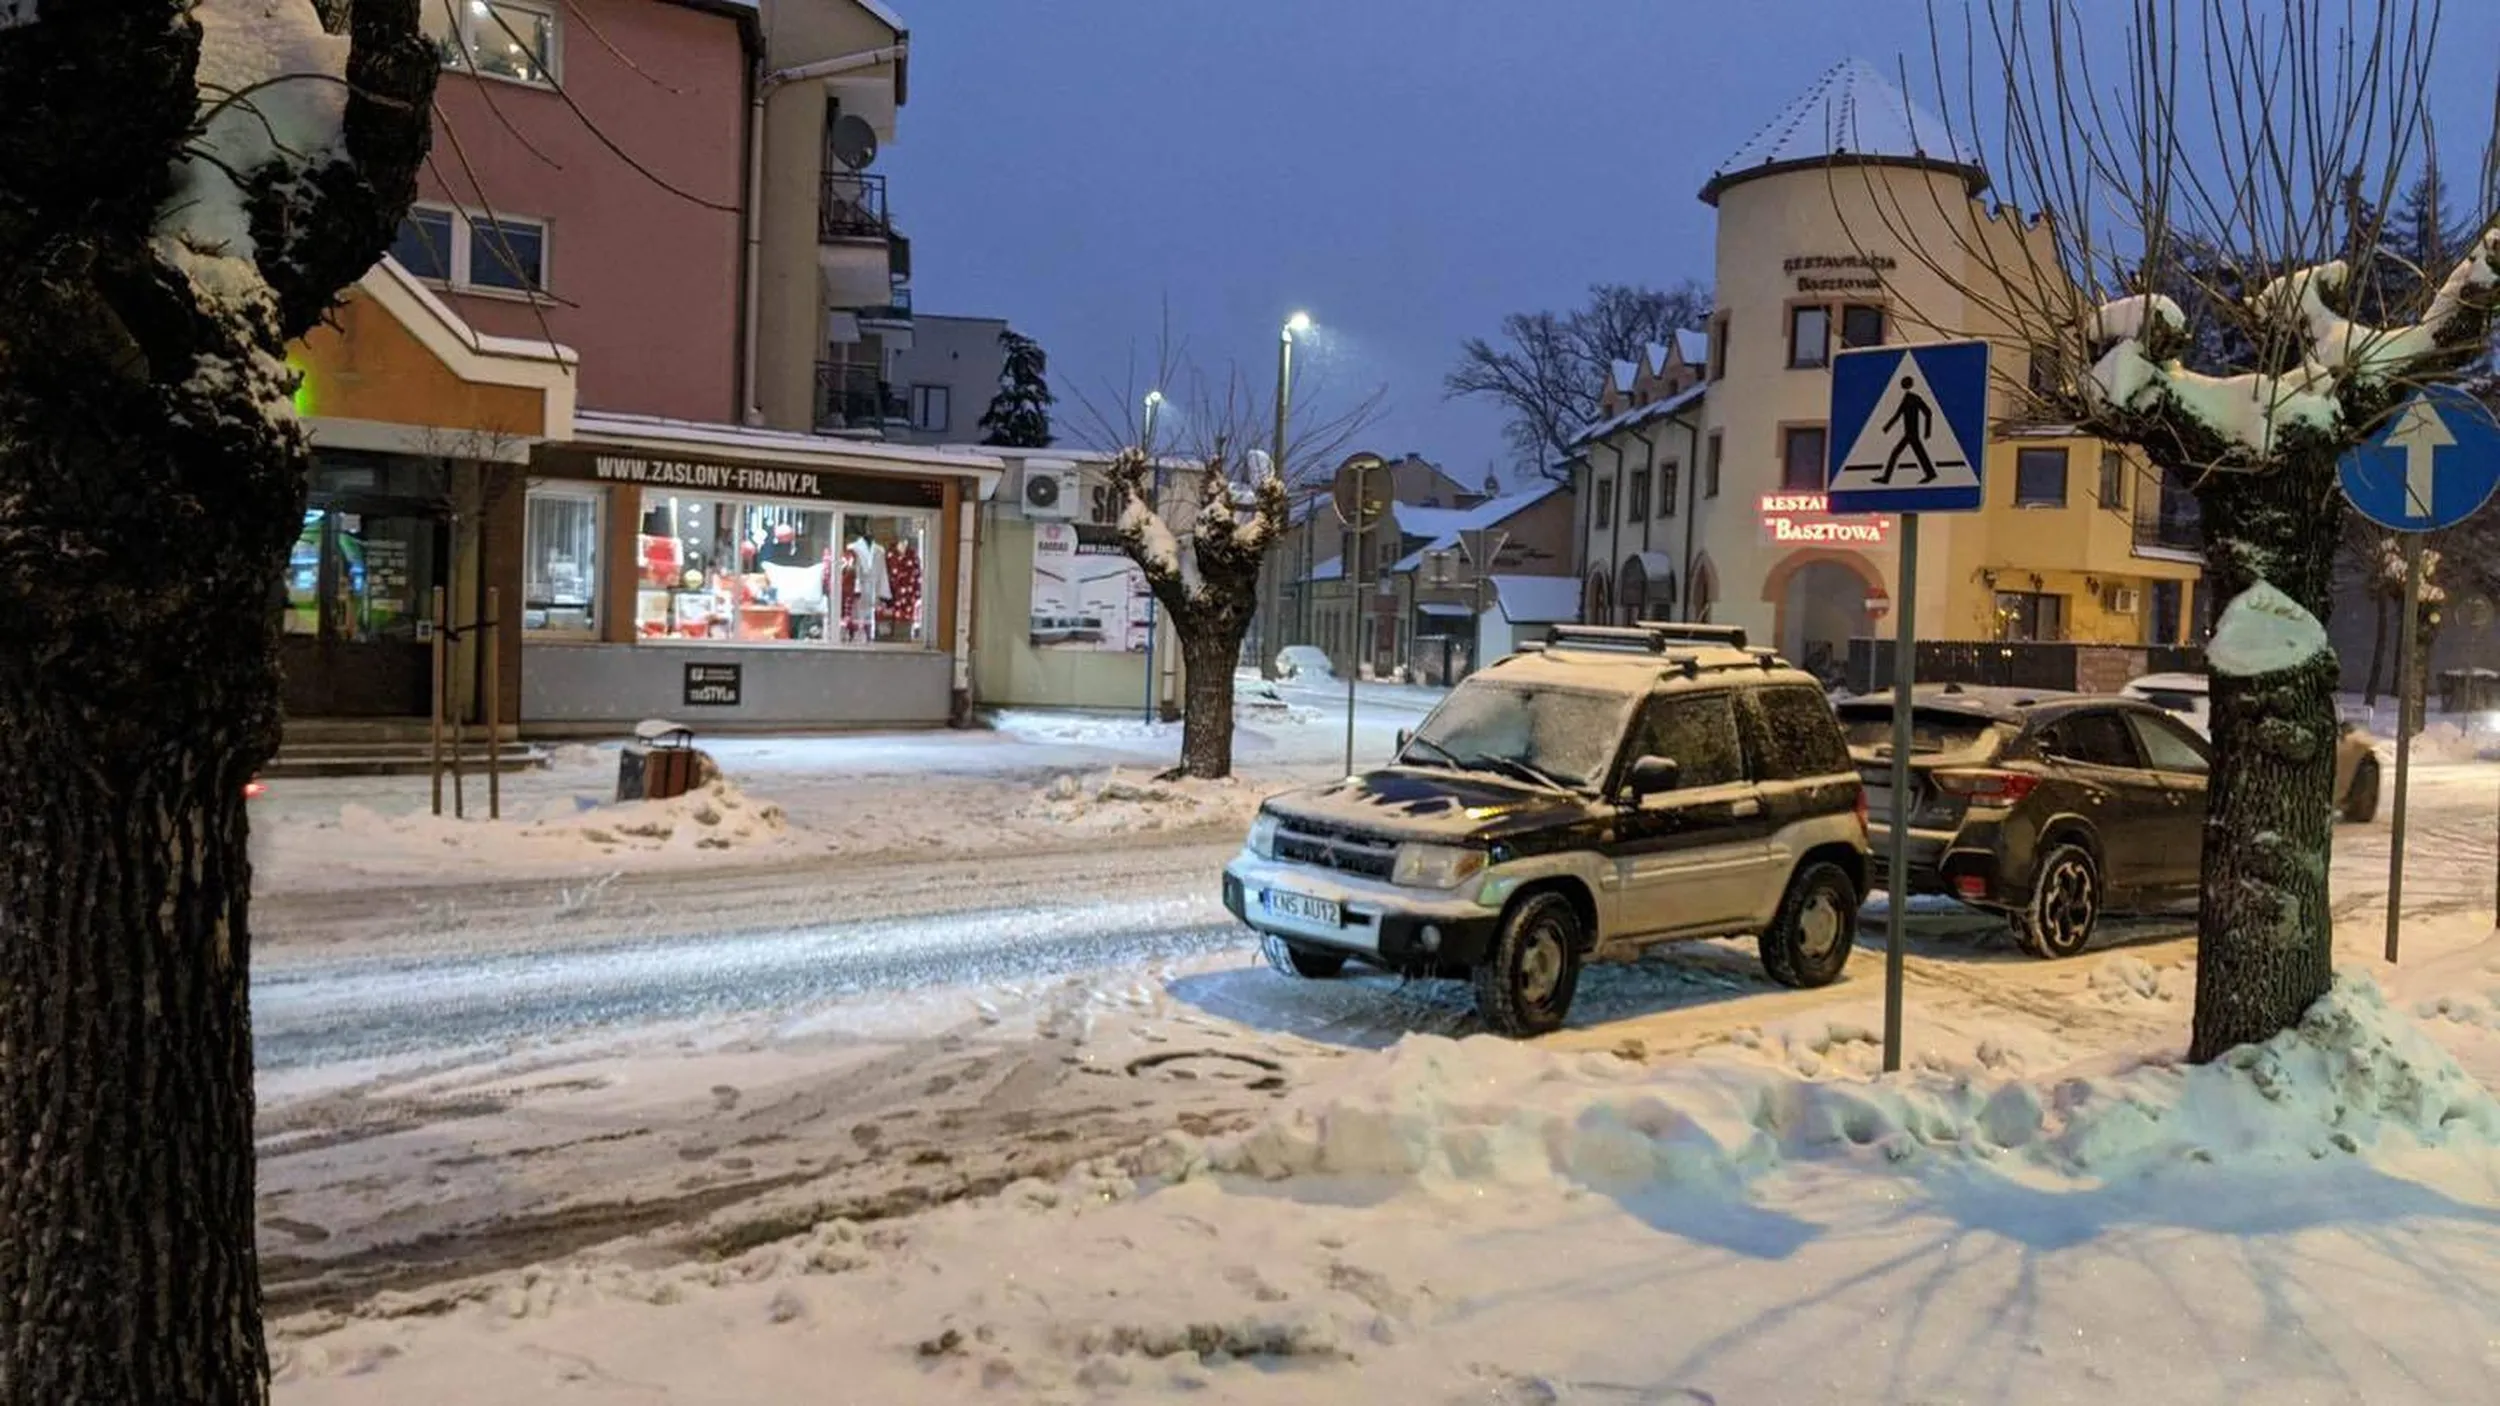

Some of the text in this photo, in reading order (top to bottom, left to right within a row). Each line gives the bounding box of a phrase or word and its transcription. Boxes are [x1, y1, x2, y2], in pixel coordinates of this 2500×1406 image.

[597, 457, 820, 495] WWW.ZASLONY-FIRANY.PL
[1273, 894, 1337, 923] KNS AU12
